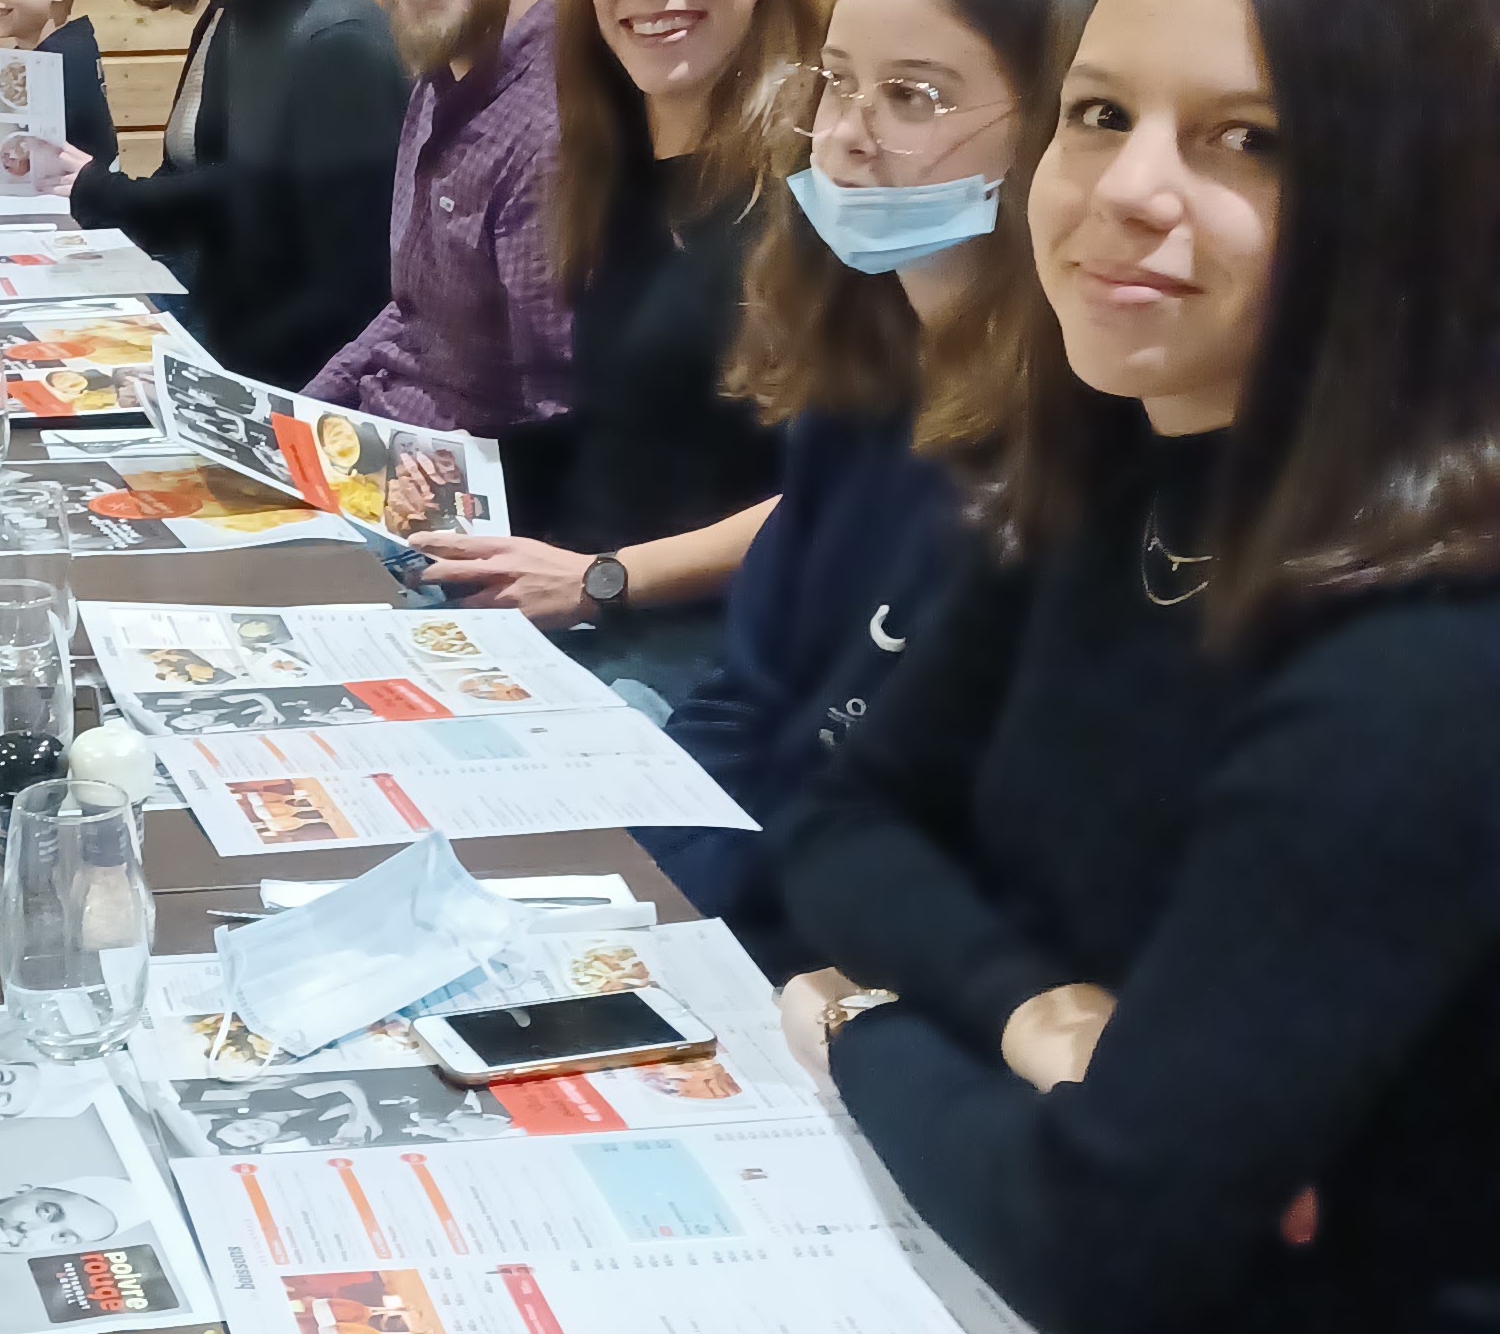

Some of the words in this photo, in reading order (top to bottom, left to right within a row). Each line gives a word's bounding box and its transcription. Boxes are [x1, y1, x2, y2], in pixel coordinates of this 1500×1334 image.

[80, 1252, 125, 1312] rouge
[104, 1251, 149, 1310] poivre
[228, 1245, 257, 1291] boissons
